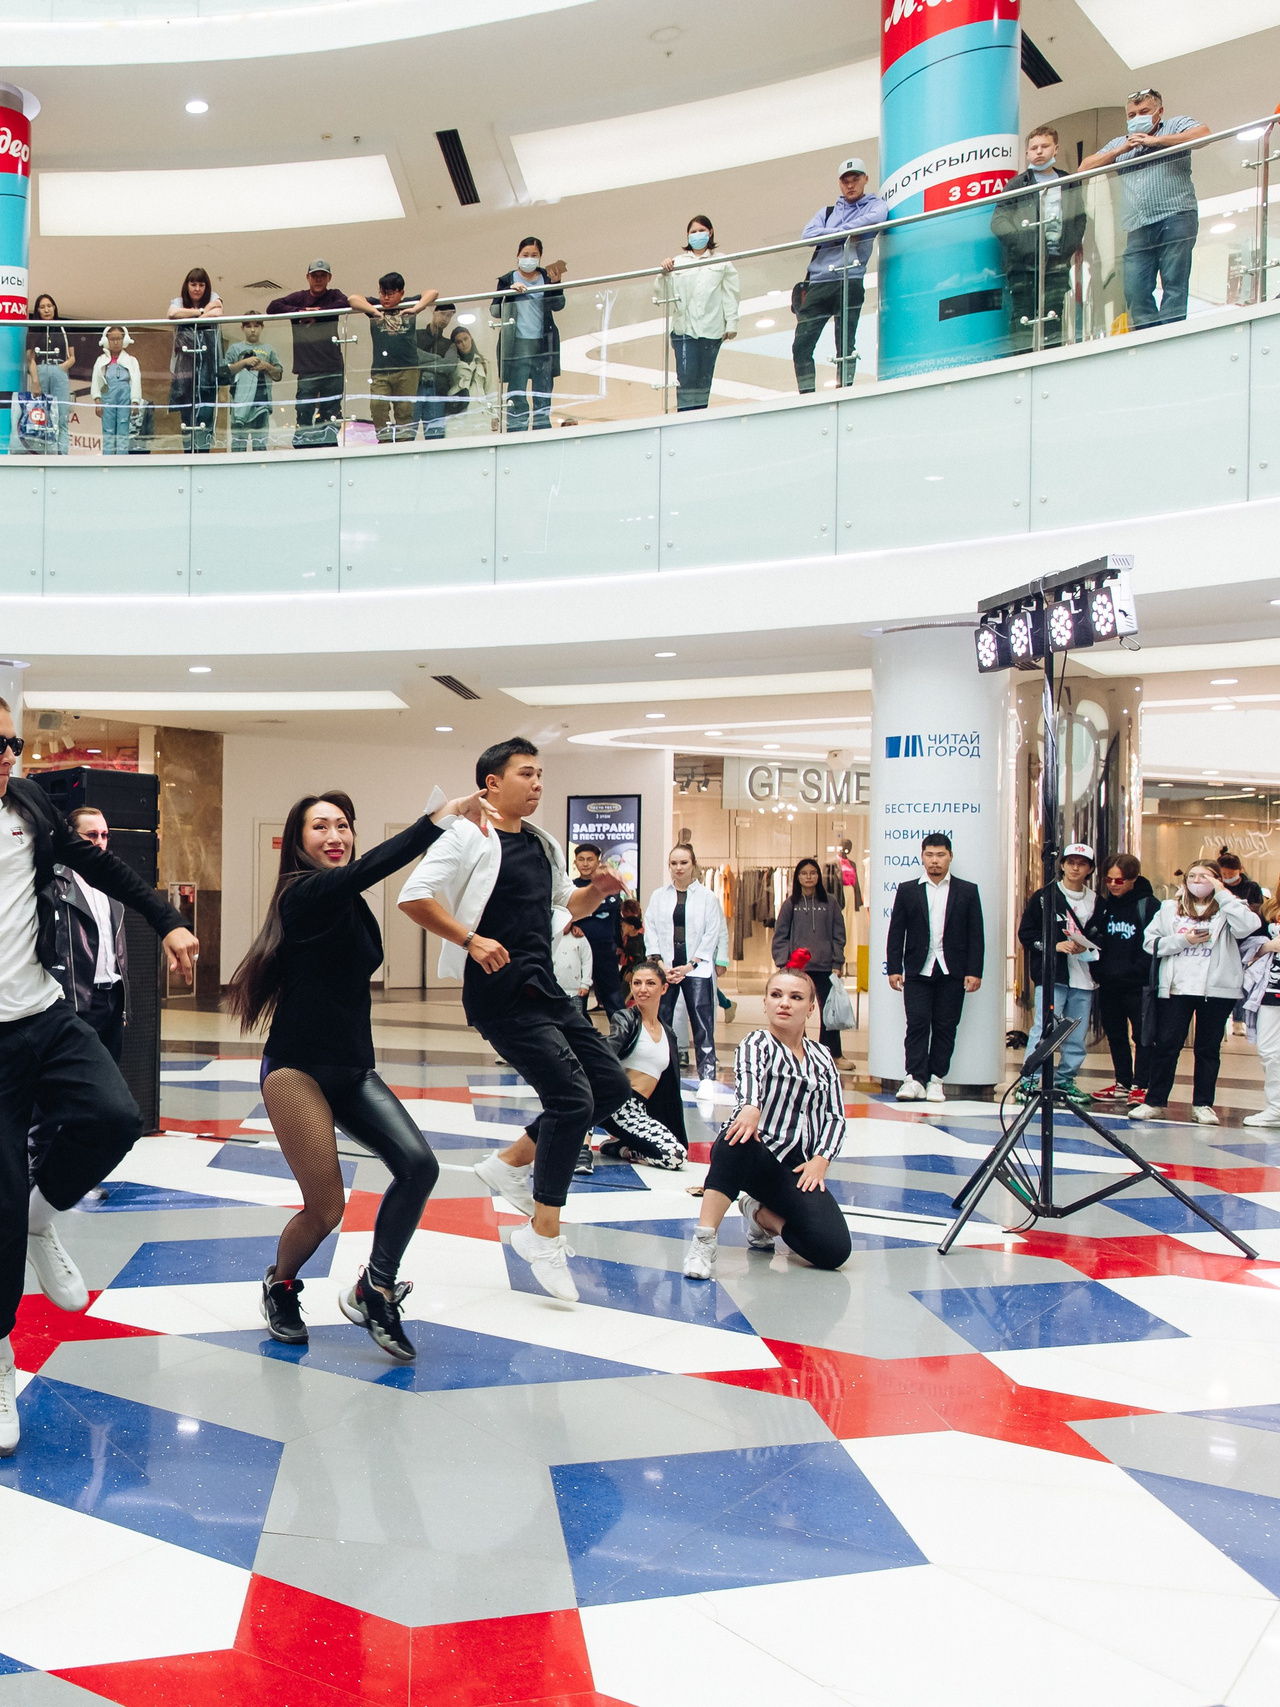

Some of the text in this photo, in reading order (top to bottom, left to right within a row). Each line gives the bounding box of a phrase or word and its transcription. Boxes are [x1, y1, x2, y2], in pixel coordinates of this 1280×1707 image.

[901, 146, 1012, 188] ОТКРЫЛИСЬ!
[948, 178, 1009, 202] 3 ЭТА
[927, 731, 980, 745] ЧИТАЙ
[927, 746, 981, 758] ГОРОД
[884, 803, 981, 814] БЕСТСЕЛЛЕРЫ
[572, 823, 635, 833] ЗАВТРАКИ
[884, 855, 924, 867] ПОДА
